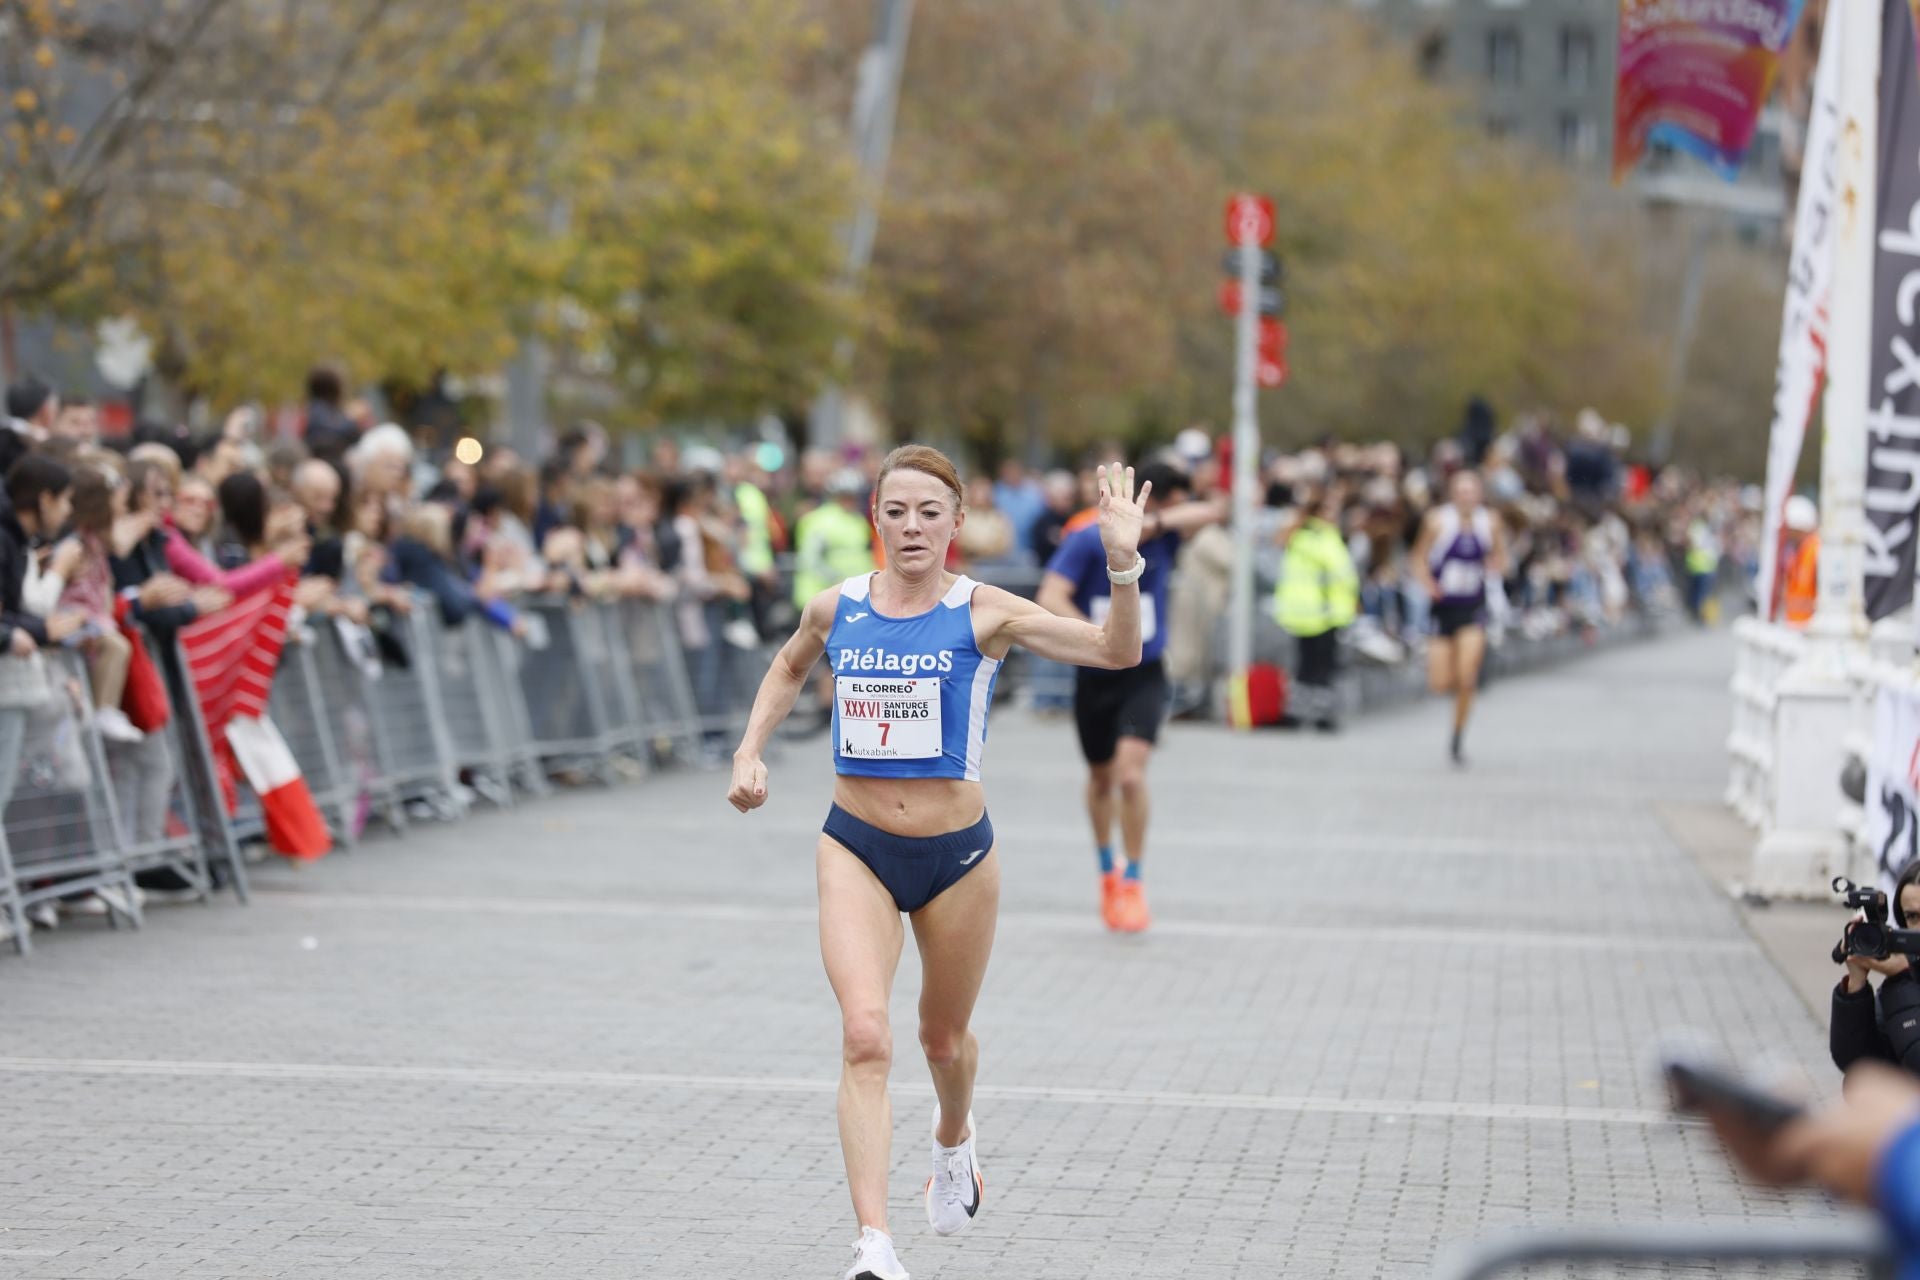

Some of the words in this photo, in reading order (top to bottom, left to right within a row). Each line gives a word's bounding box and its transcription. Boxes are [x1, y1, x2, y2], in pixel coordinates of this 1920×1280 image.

[852, 684, 864, 693] EL
[866, 684, 913, 694] CORREO
[844, 700, 880, 718] XXXVI
[884, 701, 928, 709] SANTURCE
[884, 709, 929, 719] BILBAO
[878, 723, 890, 746] 7
[853, 748, 898, 756] kutxabank
